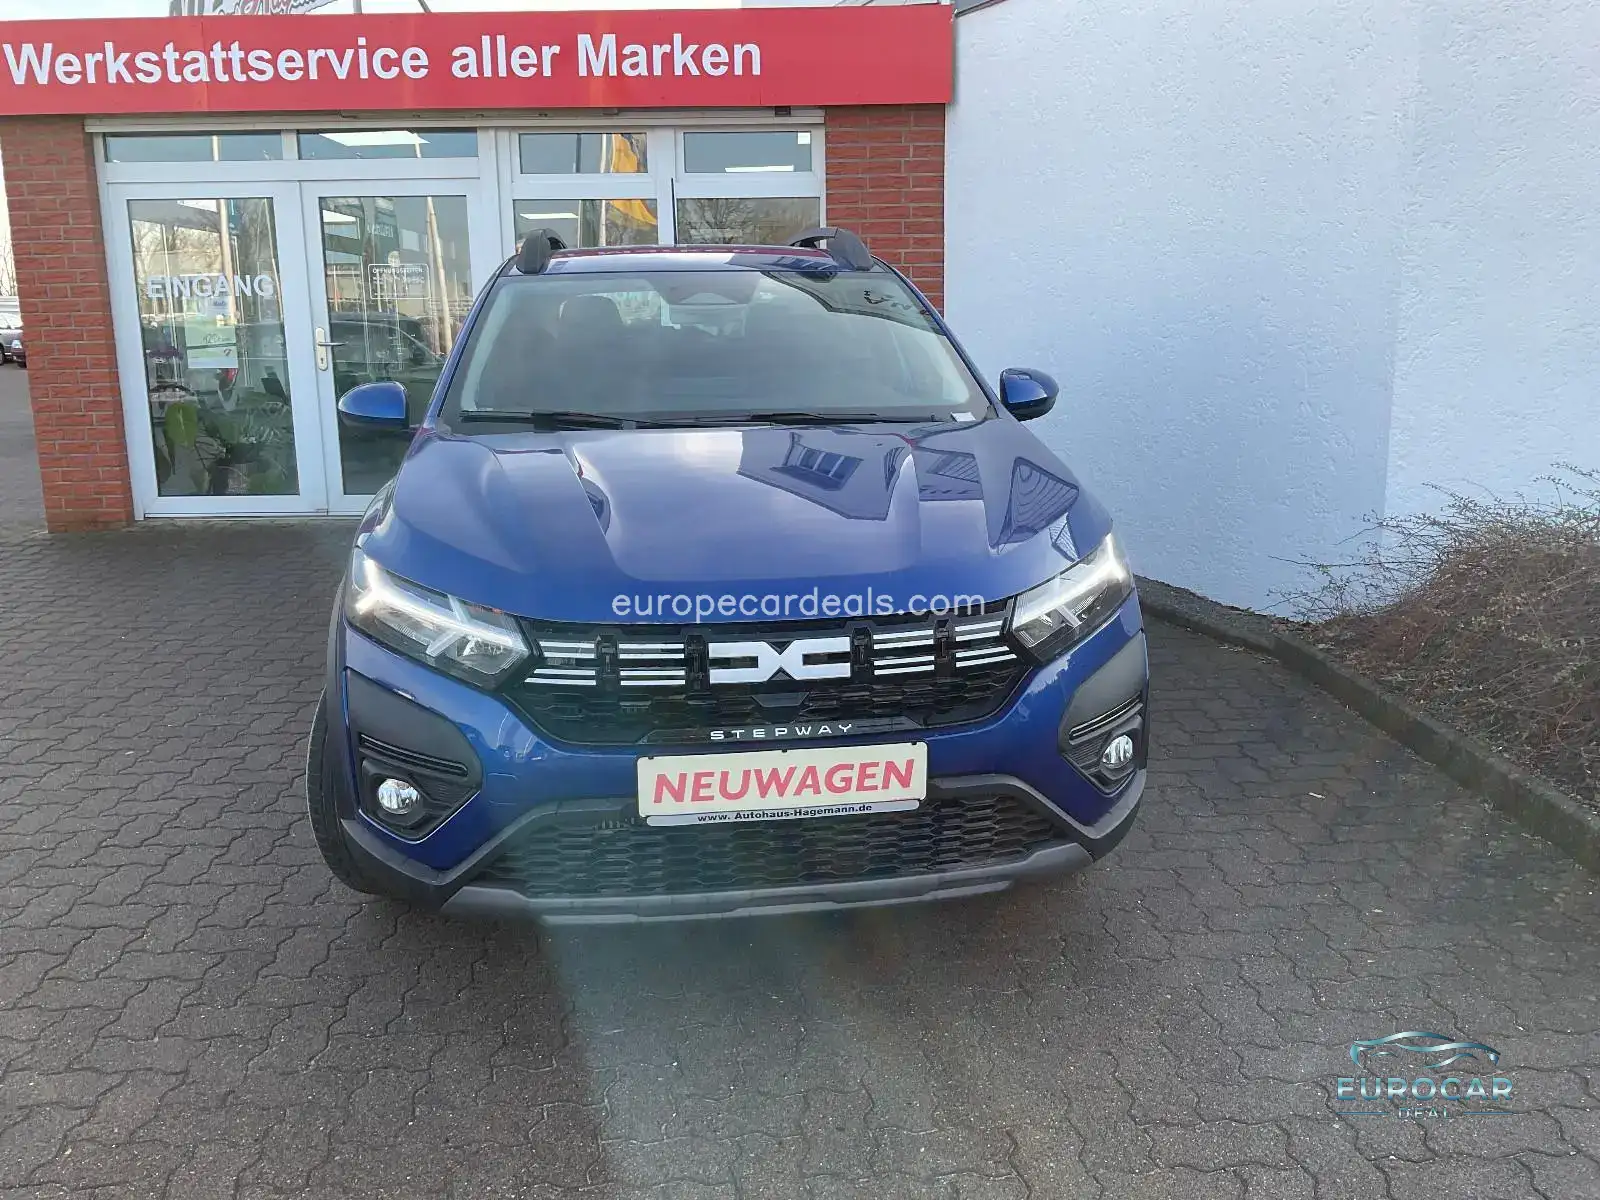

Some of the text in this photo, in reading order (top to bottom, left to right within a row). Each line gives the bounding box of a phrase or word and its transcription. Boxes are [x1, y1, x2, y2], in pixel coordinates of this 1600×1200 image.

[4, 32, 762, 86] Werkstattservice aller Marken
[147, 274, 275, 299] EINGANG
[710, 723, 852, 740] STEPWAY
[653, 758, 915, 805] NEUWAGEN
